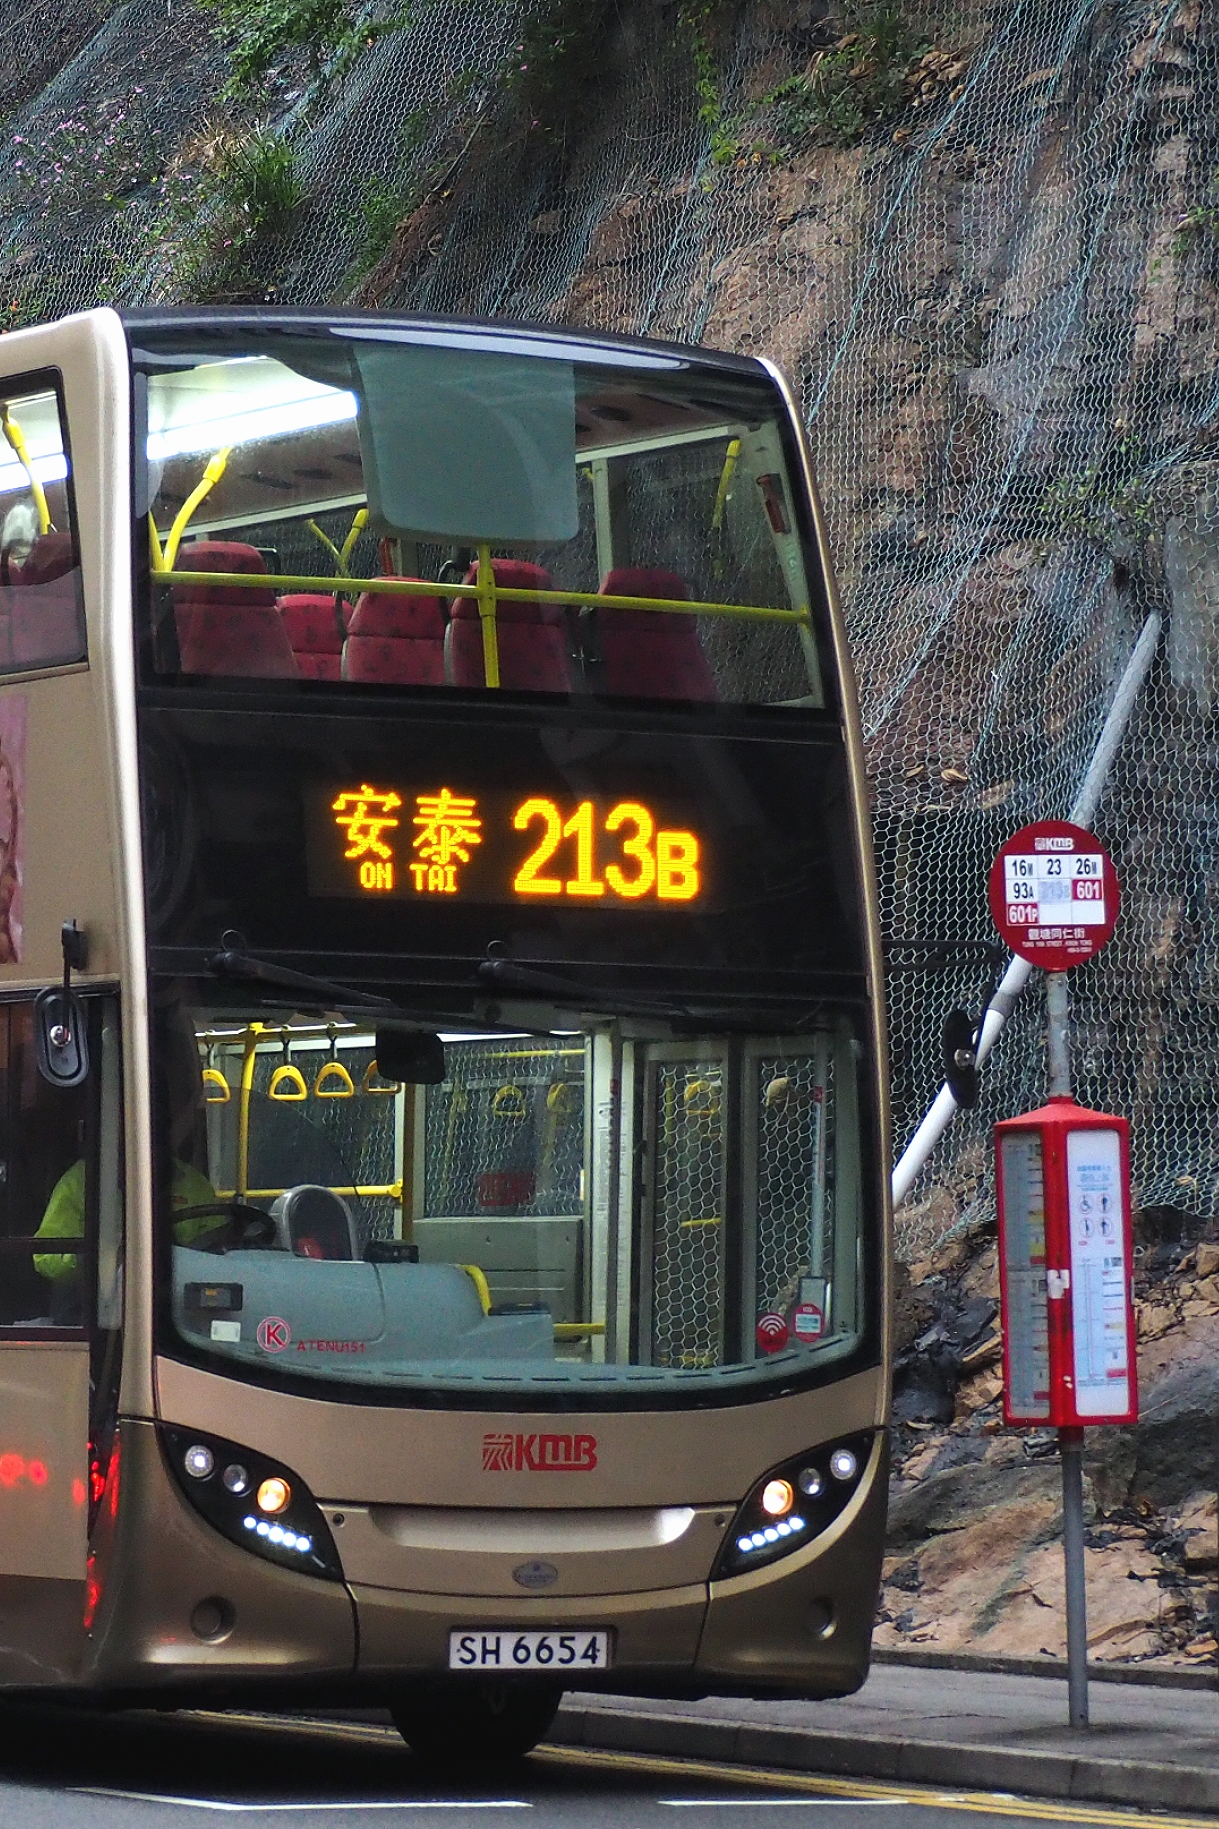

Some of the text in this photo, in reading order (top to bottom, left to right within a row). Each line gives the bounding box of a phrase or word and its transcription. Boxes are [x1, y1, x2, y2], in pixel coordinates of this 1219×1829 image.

[332, 784, 482, 864] 安泰
[514, 798, 699, 899] 213B
[359, 861, 457, 892] ON TAI
[1046, 858, 1062, 875] 23
[1013, 882, 1035, 899] 93A
[1076, 881, 1100, 899] 601
[1008, 905, 1038, 923] 601P
[515, 1434, 598, 1471] KMB
[459, 1636, 598, 1664] SH 6654
